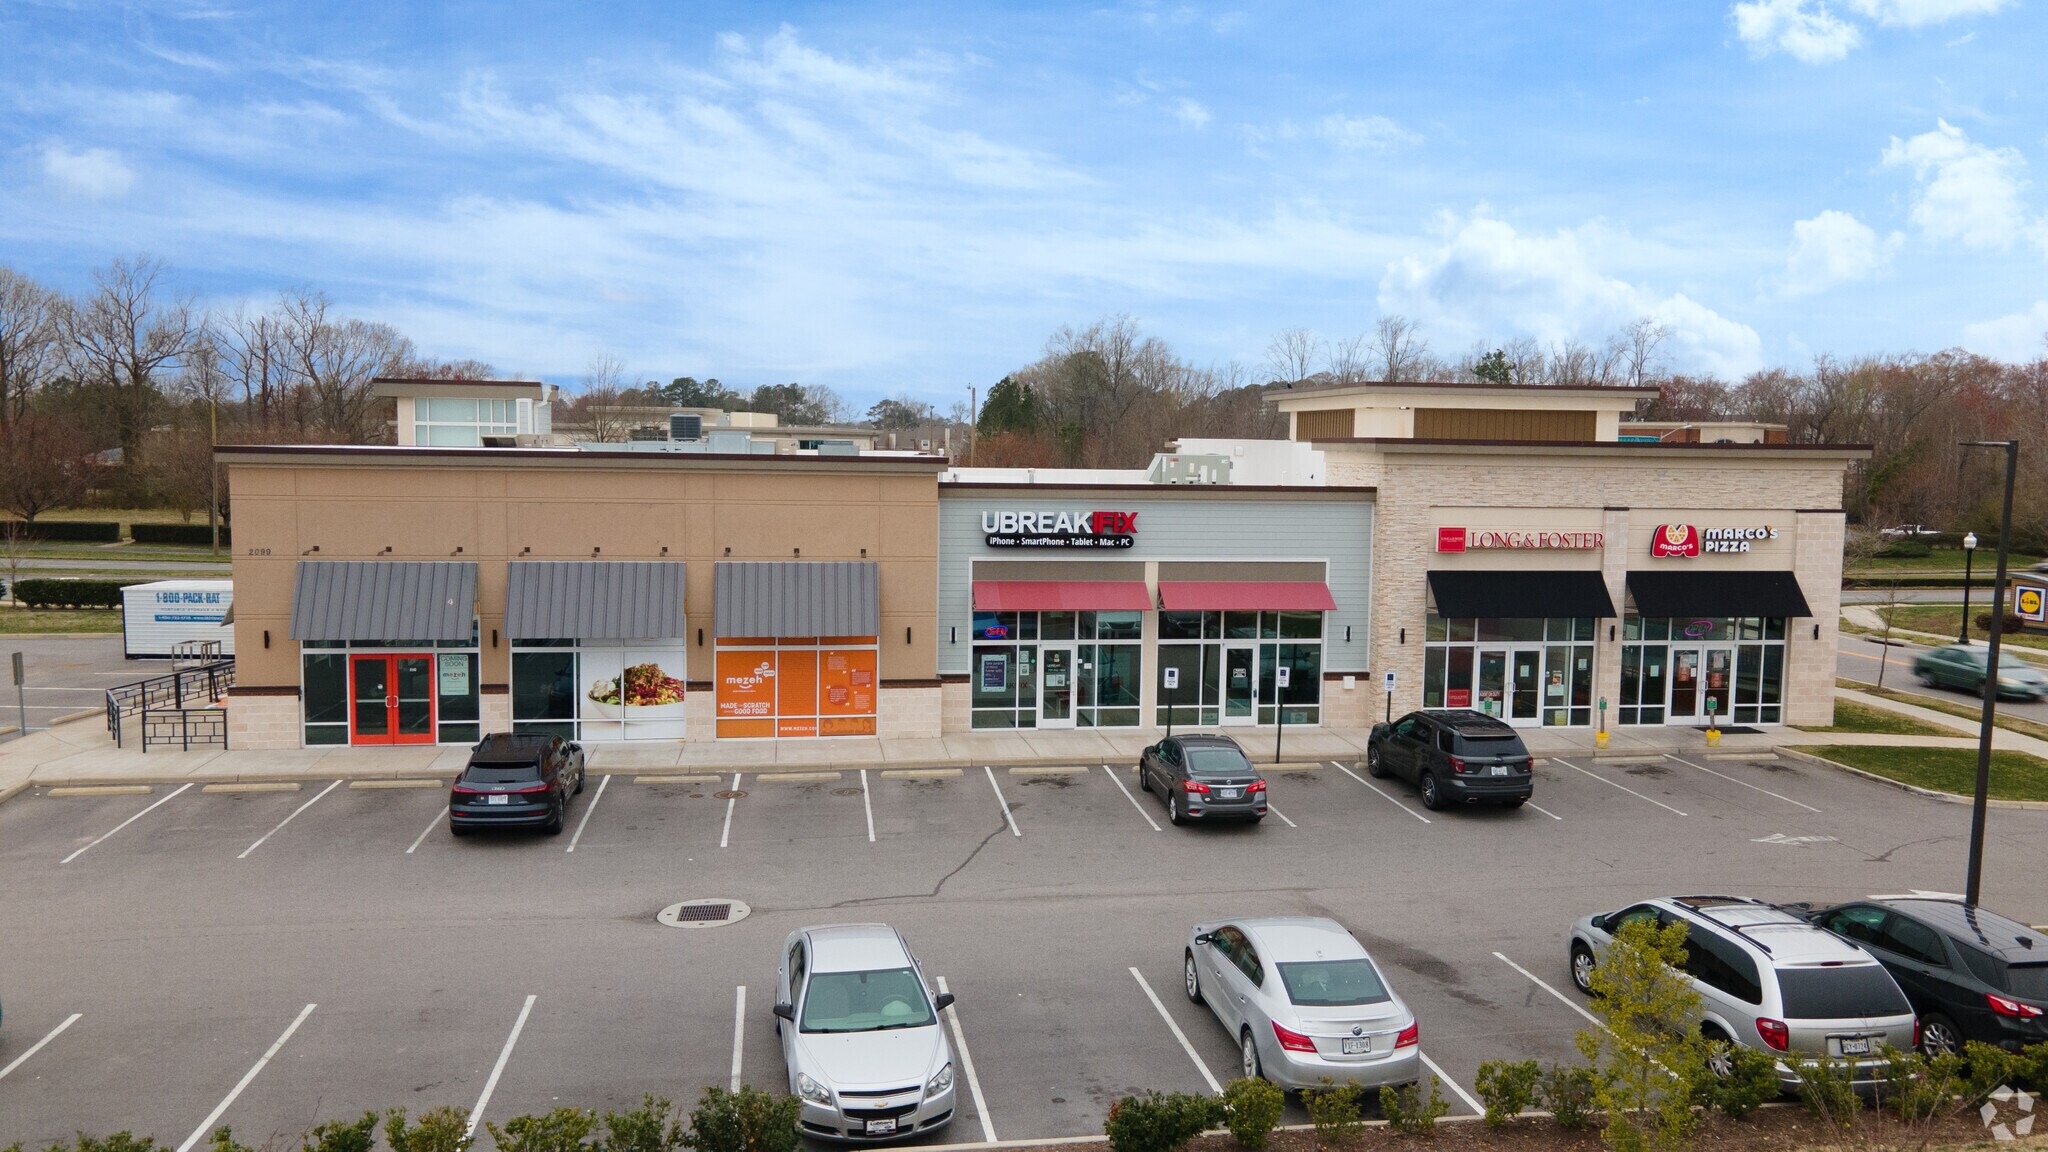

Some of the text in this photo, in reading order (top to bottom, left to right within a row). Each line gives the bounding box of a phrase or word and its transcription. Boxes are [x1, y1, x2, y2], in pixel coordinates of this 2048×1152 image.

[982, 511, 1138, 534] UBREAKIFIX
[1471, 532, 1604, 548] LONG & FOSTER
[1706, 526, 1778, 540] MARCO'S
[1706, 541, 1750, 552] PIZZA
[726, 676, 762, 684] mezeh
